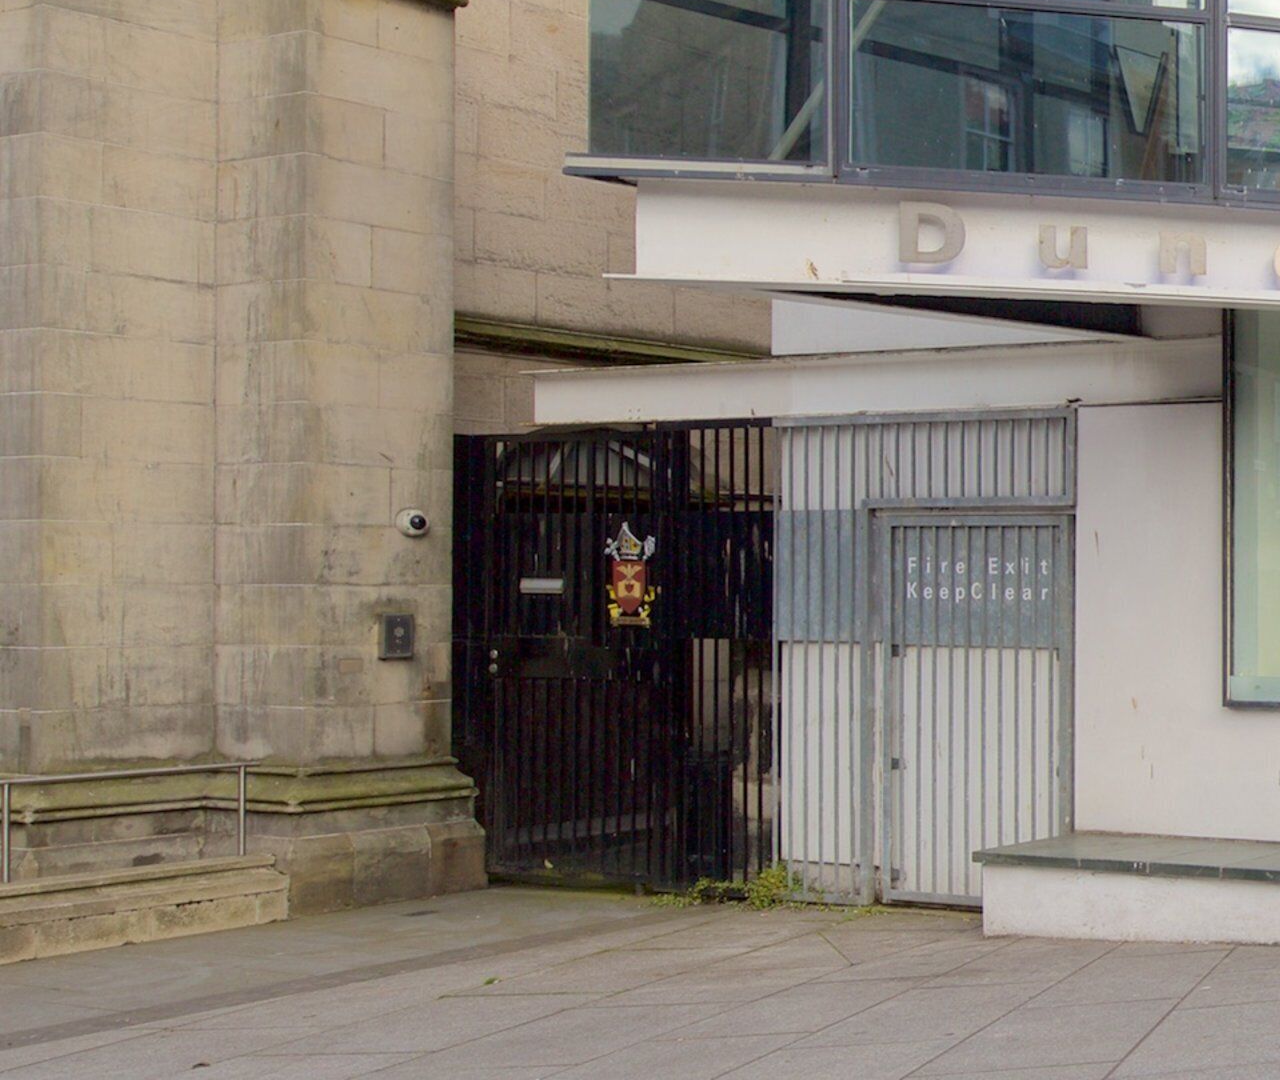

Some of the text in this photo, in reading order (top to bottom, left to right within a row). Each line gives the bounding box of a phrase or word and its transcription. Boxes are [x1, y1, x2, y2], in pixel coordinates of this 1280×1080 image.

[907, 556, 1049, 575] Fire Exit
[907, 582, 1049, 604] Keep Clear
